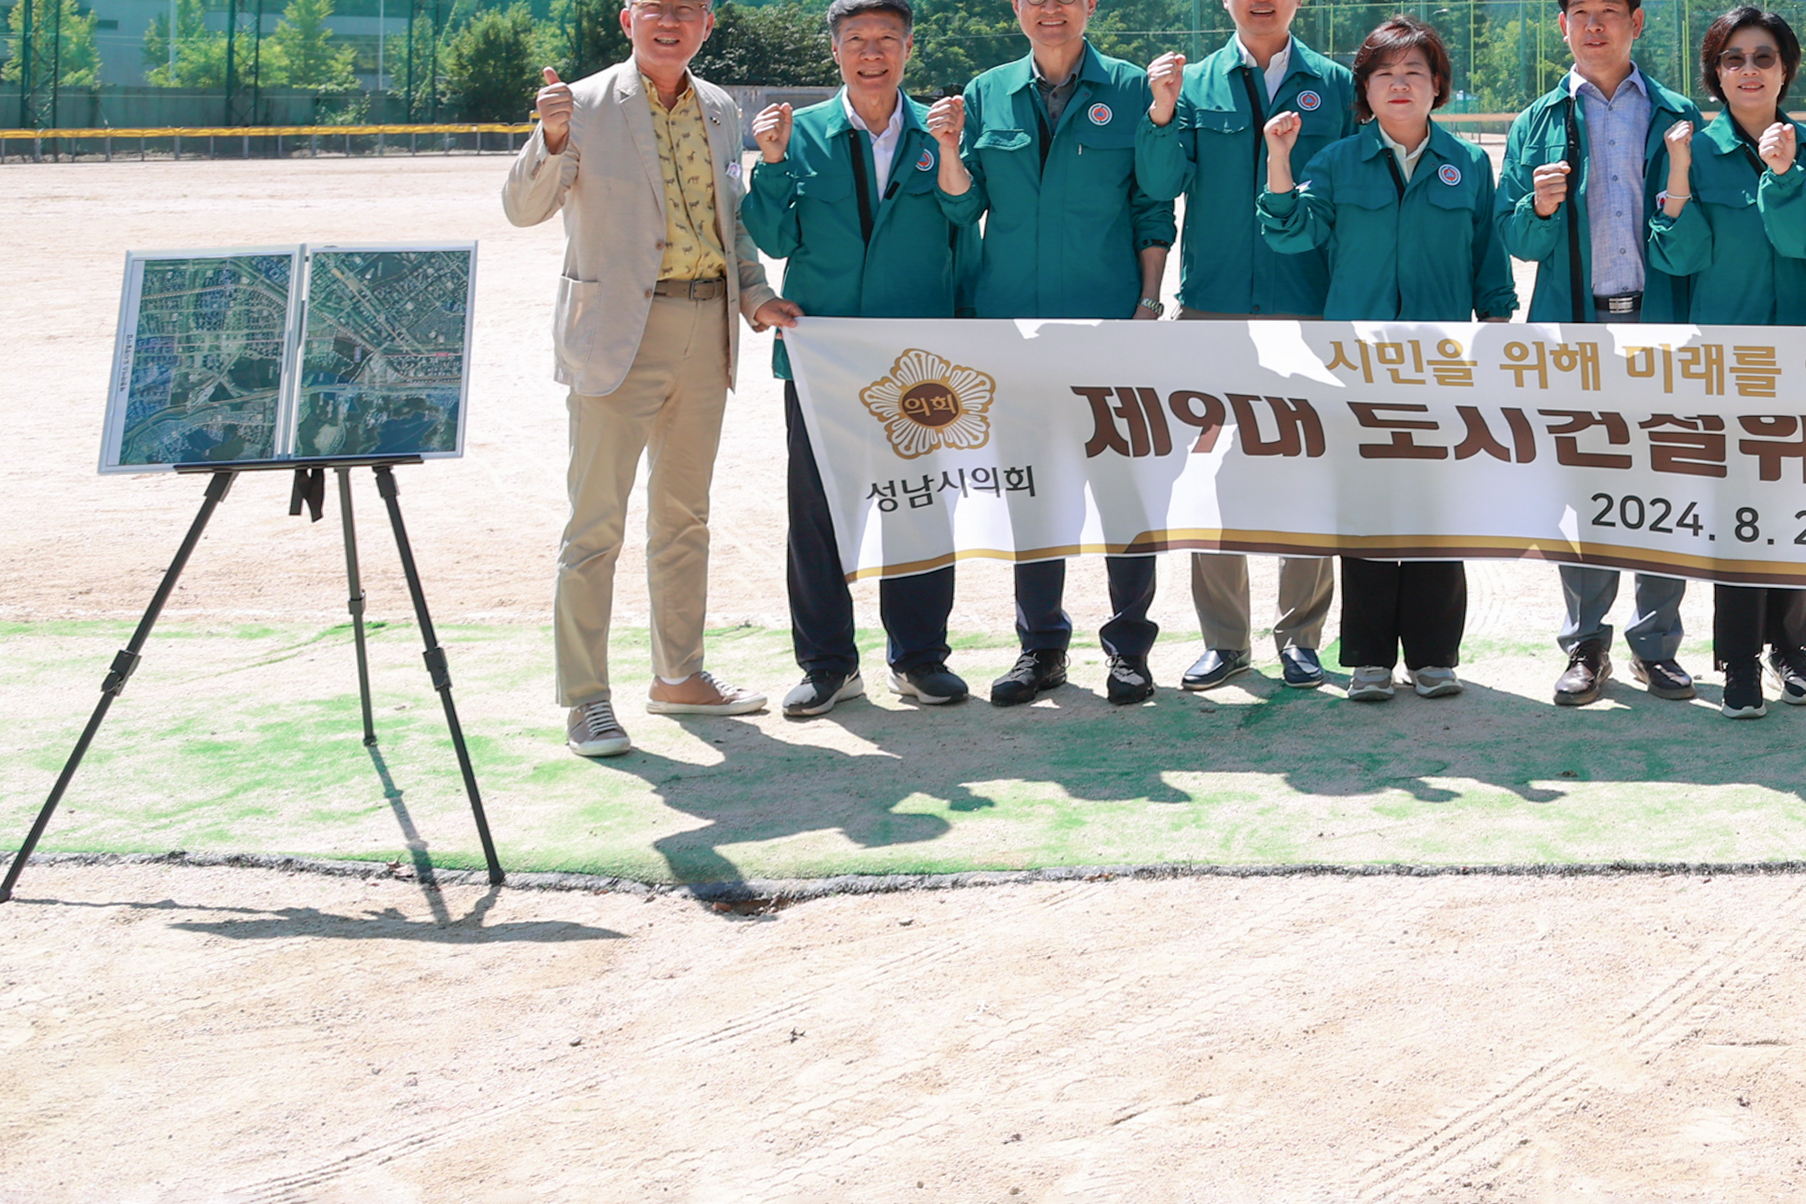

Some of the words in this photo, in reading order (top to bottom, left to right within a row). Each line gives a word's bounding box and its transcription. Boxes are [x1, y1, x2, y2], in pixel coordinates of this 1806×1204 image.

[1326, 338, 1478, 388] 시민을
[1499, 340, 1602, 391] 위해
[1622, 343, 1782, 398] 미래를
[904, 394, 957, 416] 의회
[1070, 385, 1326, 459] 제9대
[866, 465, 1036, 513] 성남시의회
[1591, 492, 1717, 542] 2024.
[1734, 506, 1775, 546] 8.
